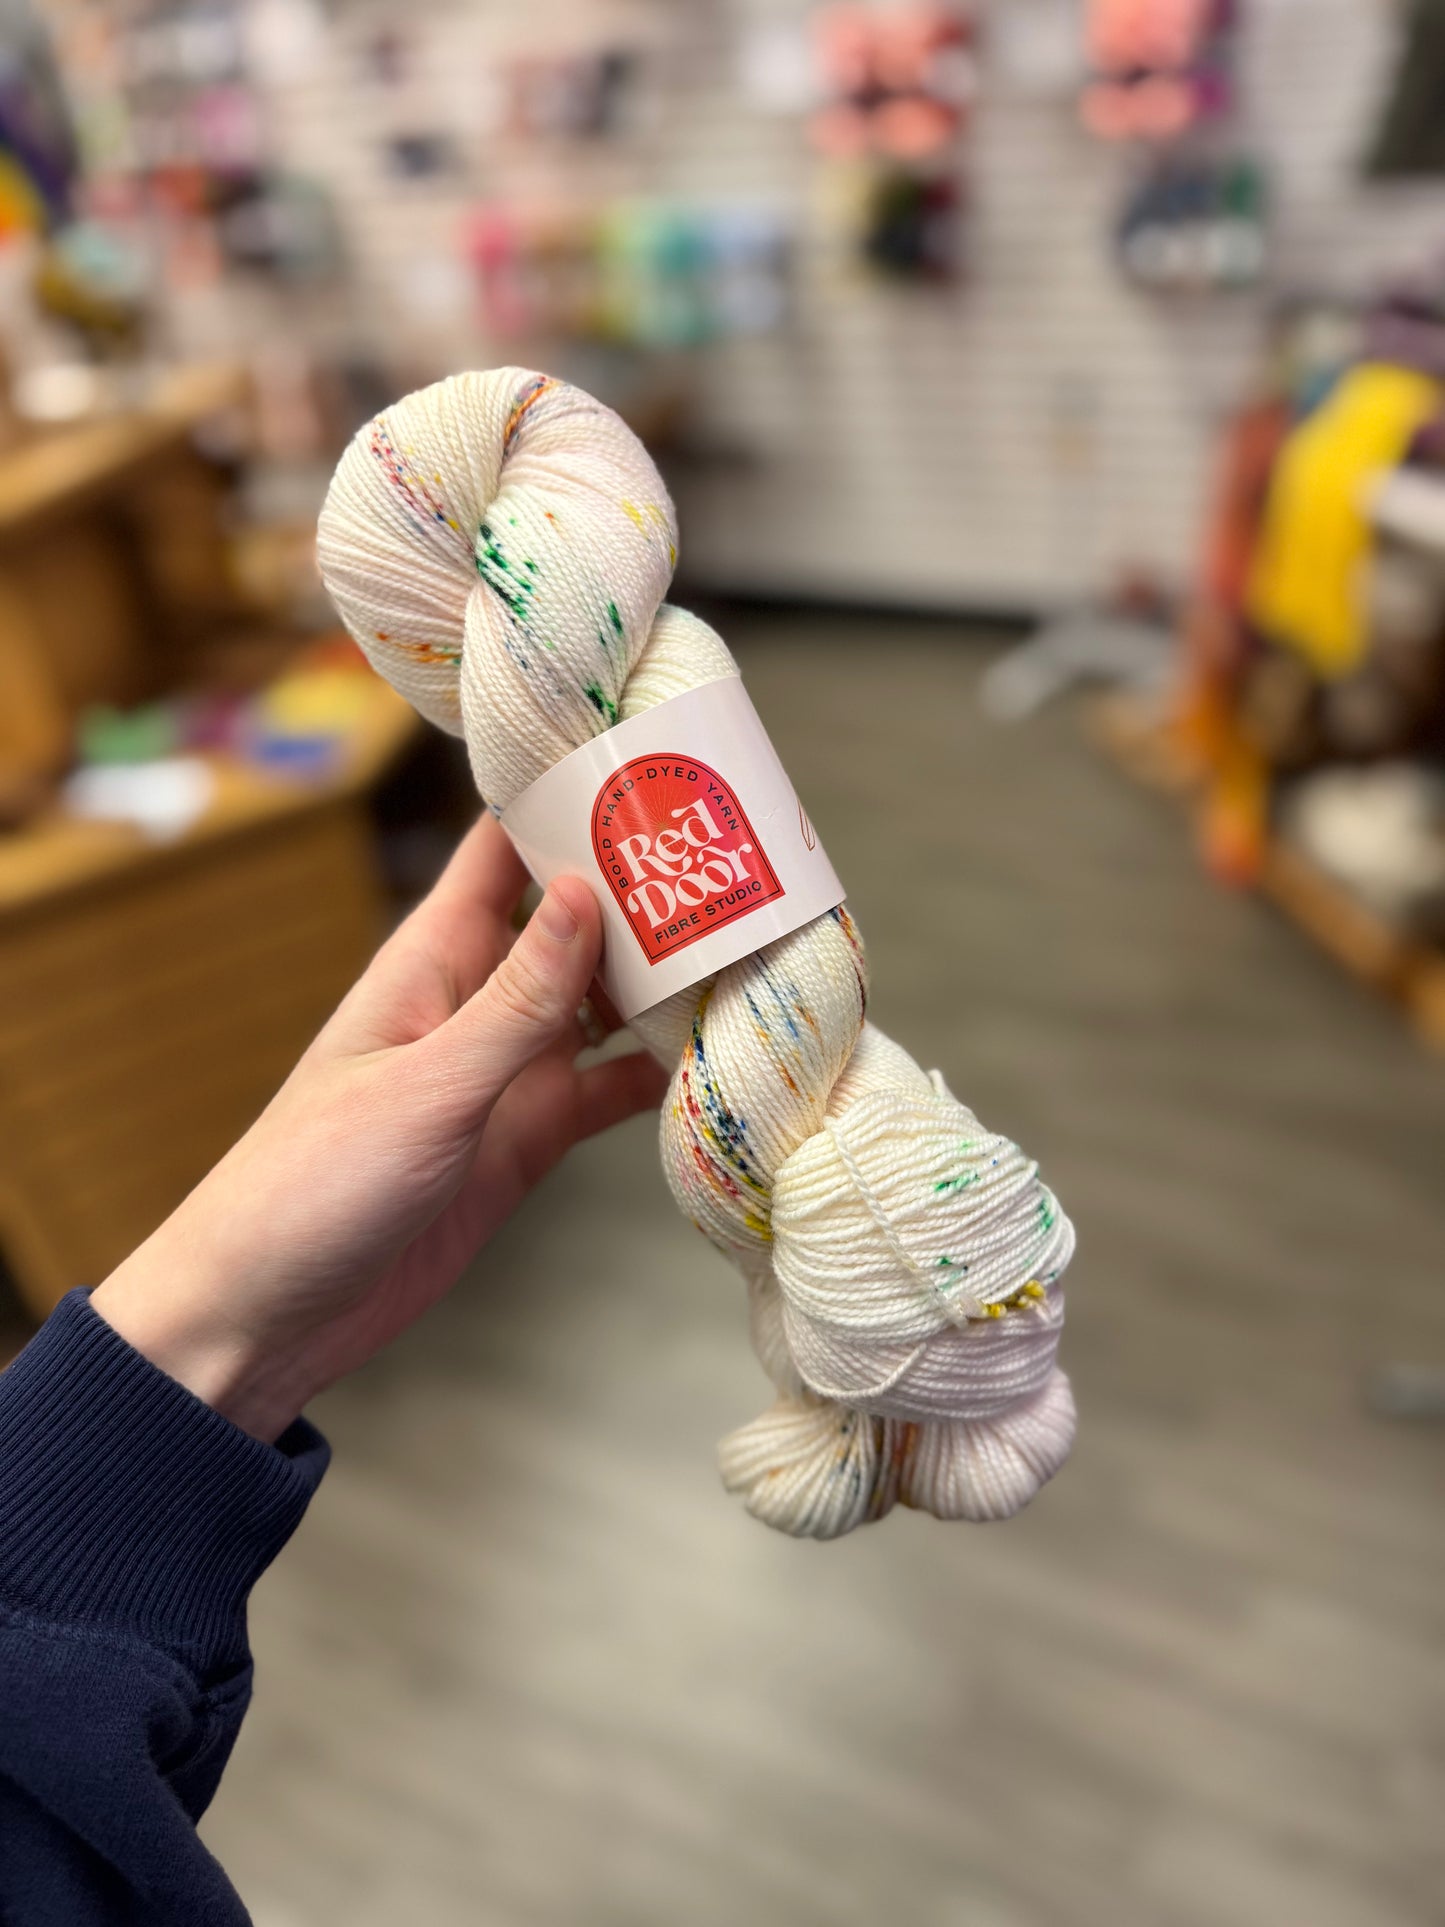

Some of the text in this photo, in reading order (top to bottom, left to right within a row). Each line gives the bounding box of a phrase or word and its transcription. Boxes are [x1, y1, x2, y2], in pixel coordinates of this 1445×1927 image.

[602, 765, 740, 889] BOLD HAND-DYED YARN
[616, 798, 724, 883] Red
[627, 843, 753, 929] Door
[655, 880, 762, 944] FIBRE STUDIO
